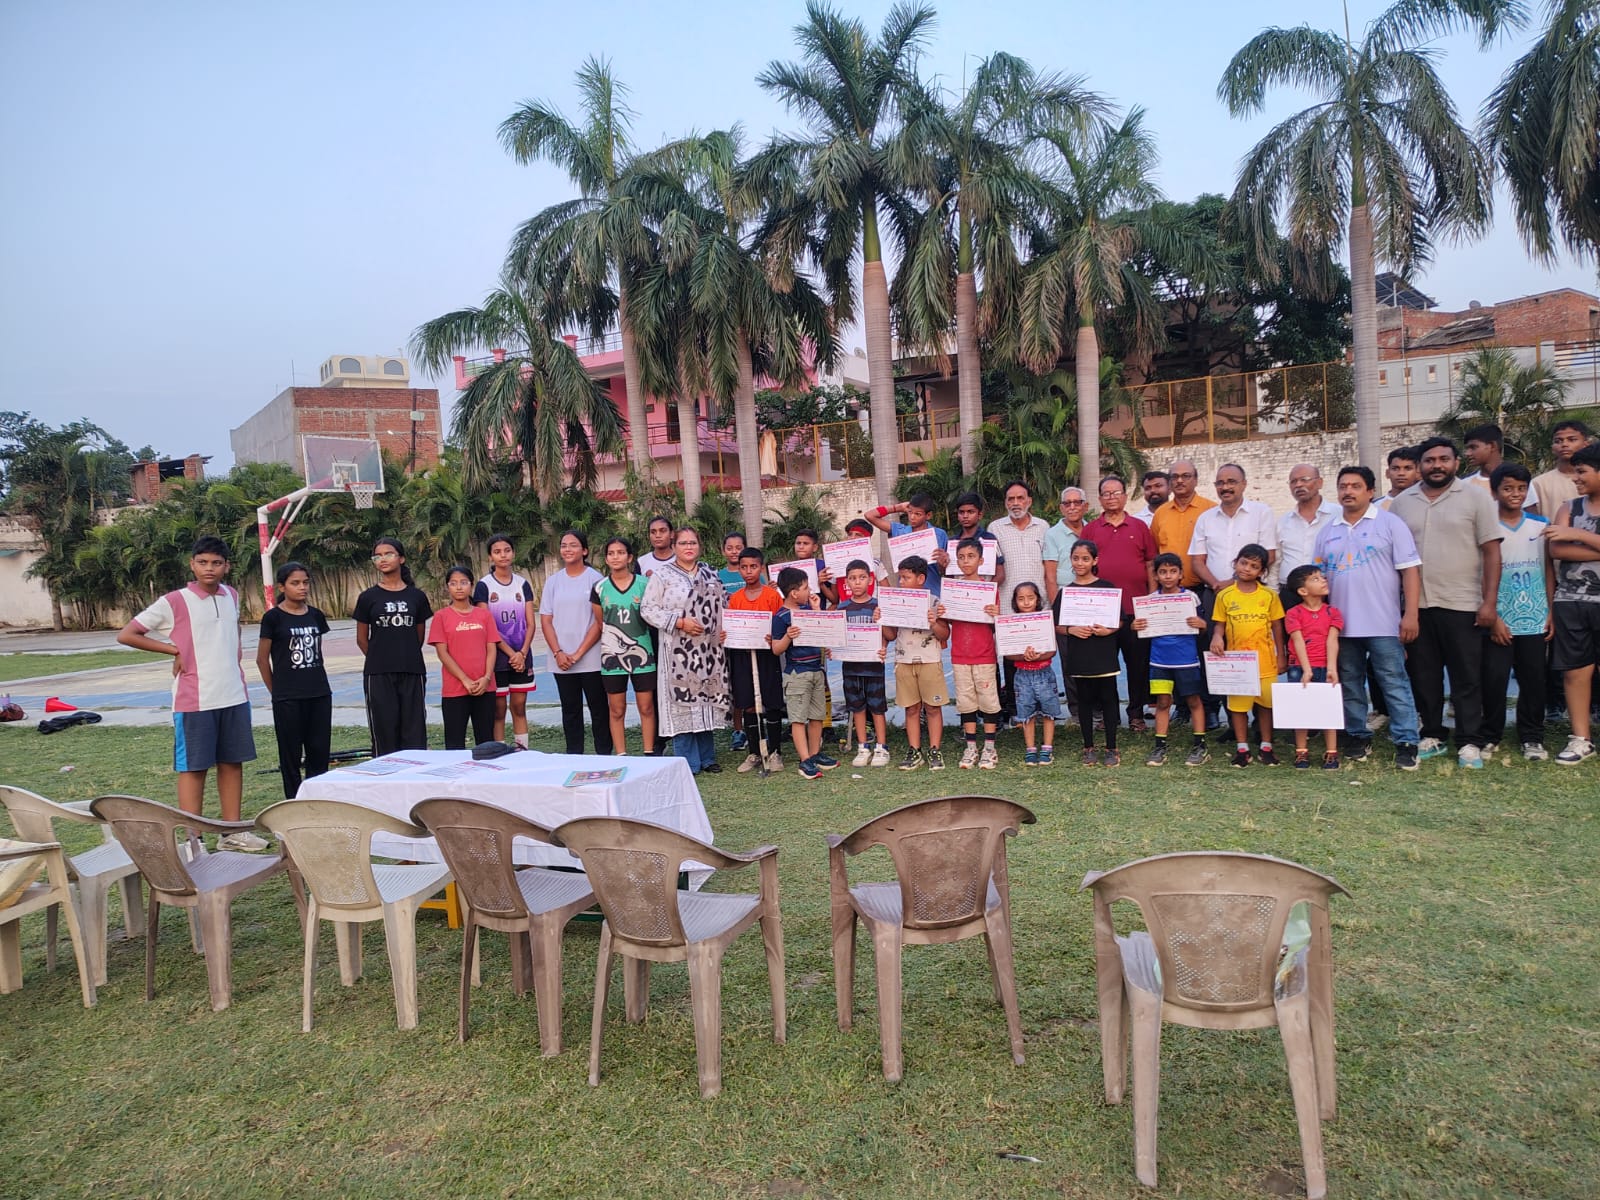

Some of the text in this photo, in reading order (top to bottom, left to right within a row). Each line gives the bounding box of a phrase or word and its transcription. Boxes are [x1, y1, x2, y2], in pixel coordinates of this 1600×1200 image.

[1511, 570, 1531, 590] 30
[385, 601, 408, 613] BE
[501, 610, 517, 623] 04
[617, 608, 631, 624] 12
